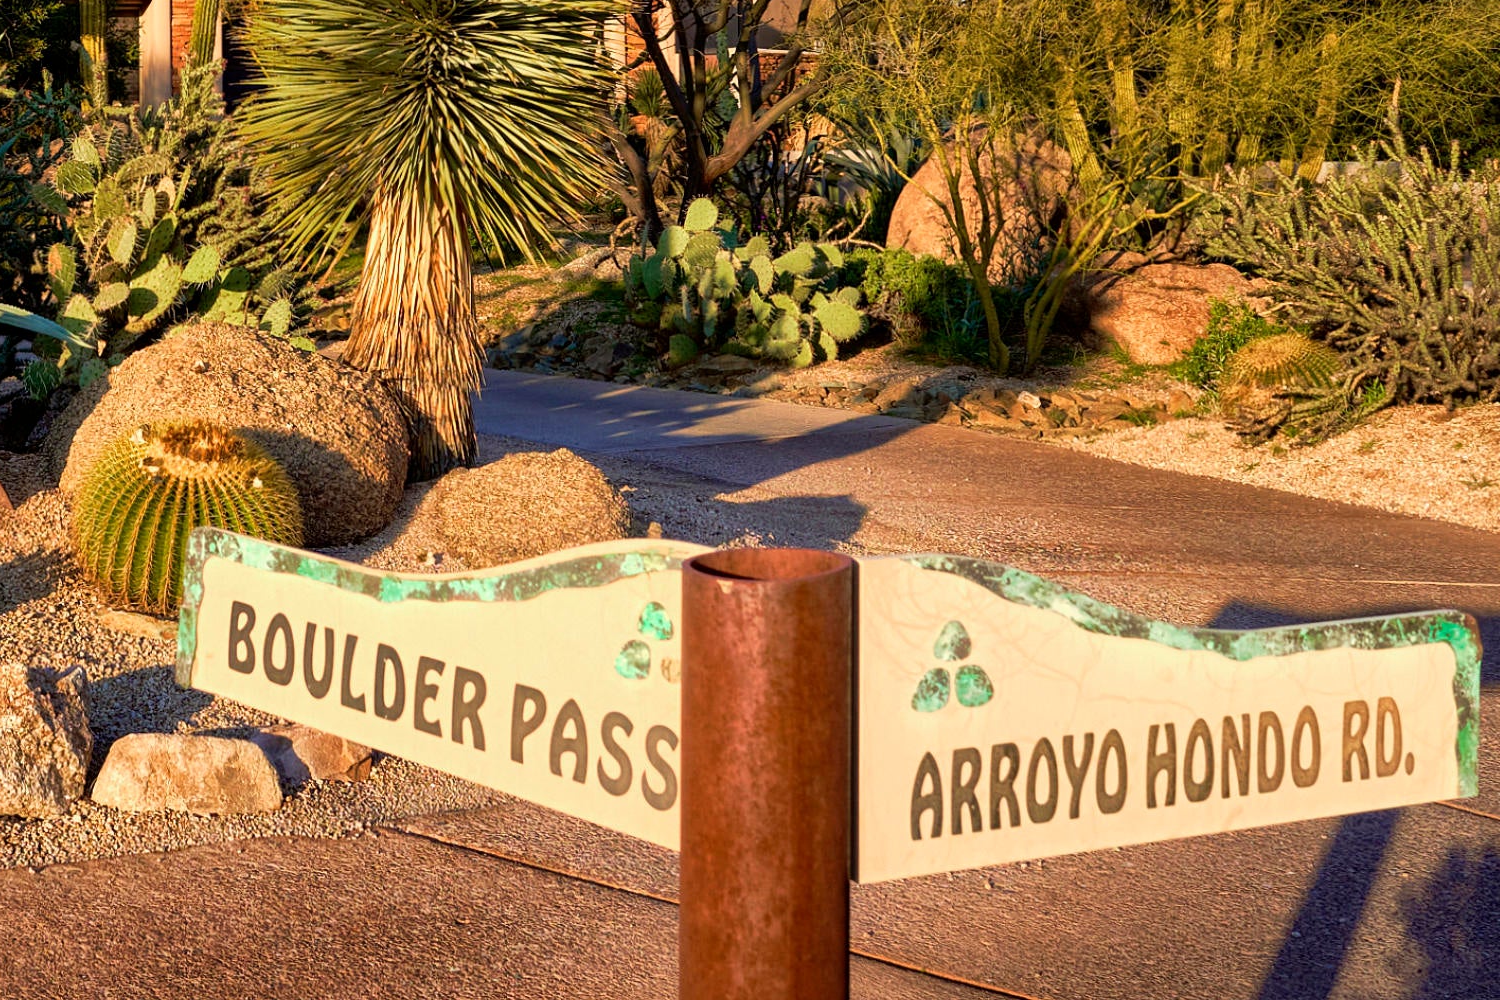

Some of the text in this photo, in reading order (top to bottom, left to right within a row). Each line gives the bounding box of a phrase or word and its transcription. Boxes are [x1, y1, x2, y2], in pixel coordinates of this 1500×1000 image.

[228, 600, 679, 812] BOULDER PASS
[910, 696, 1415, 841] ARROYO HONDO RD.
